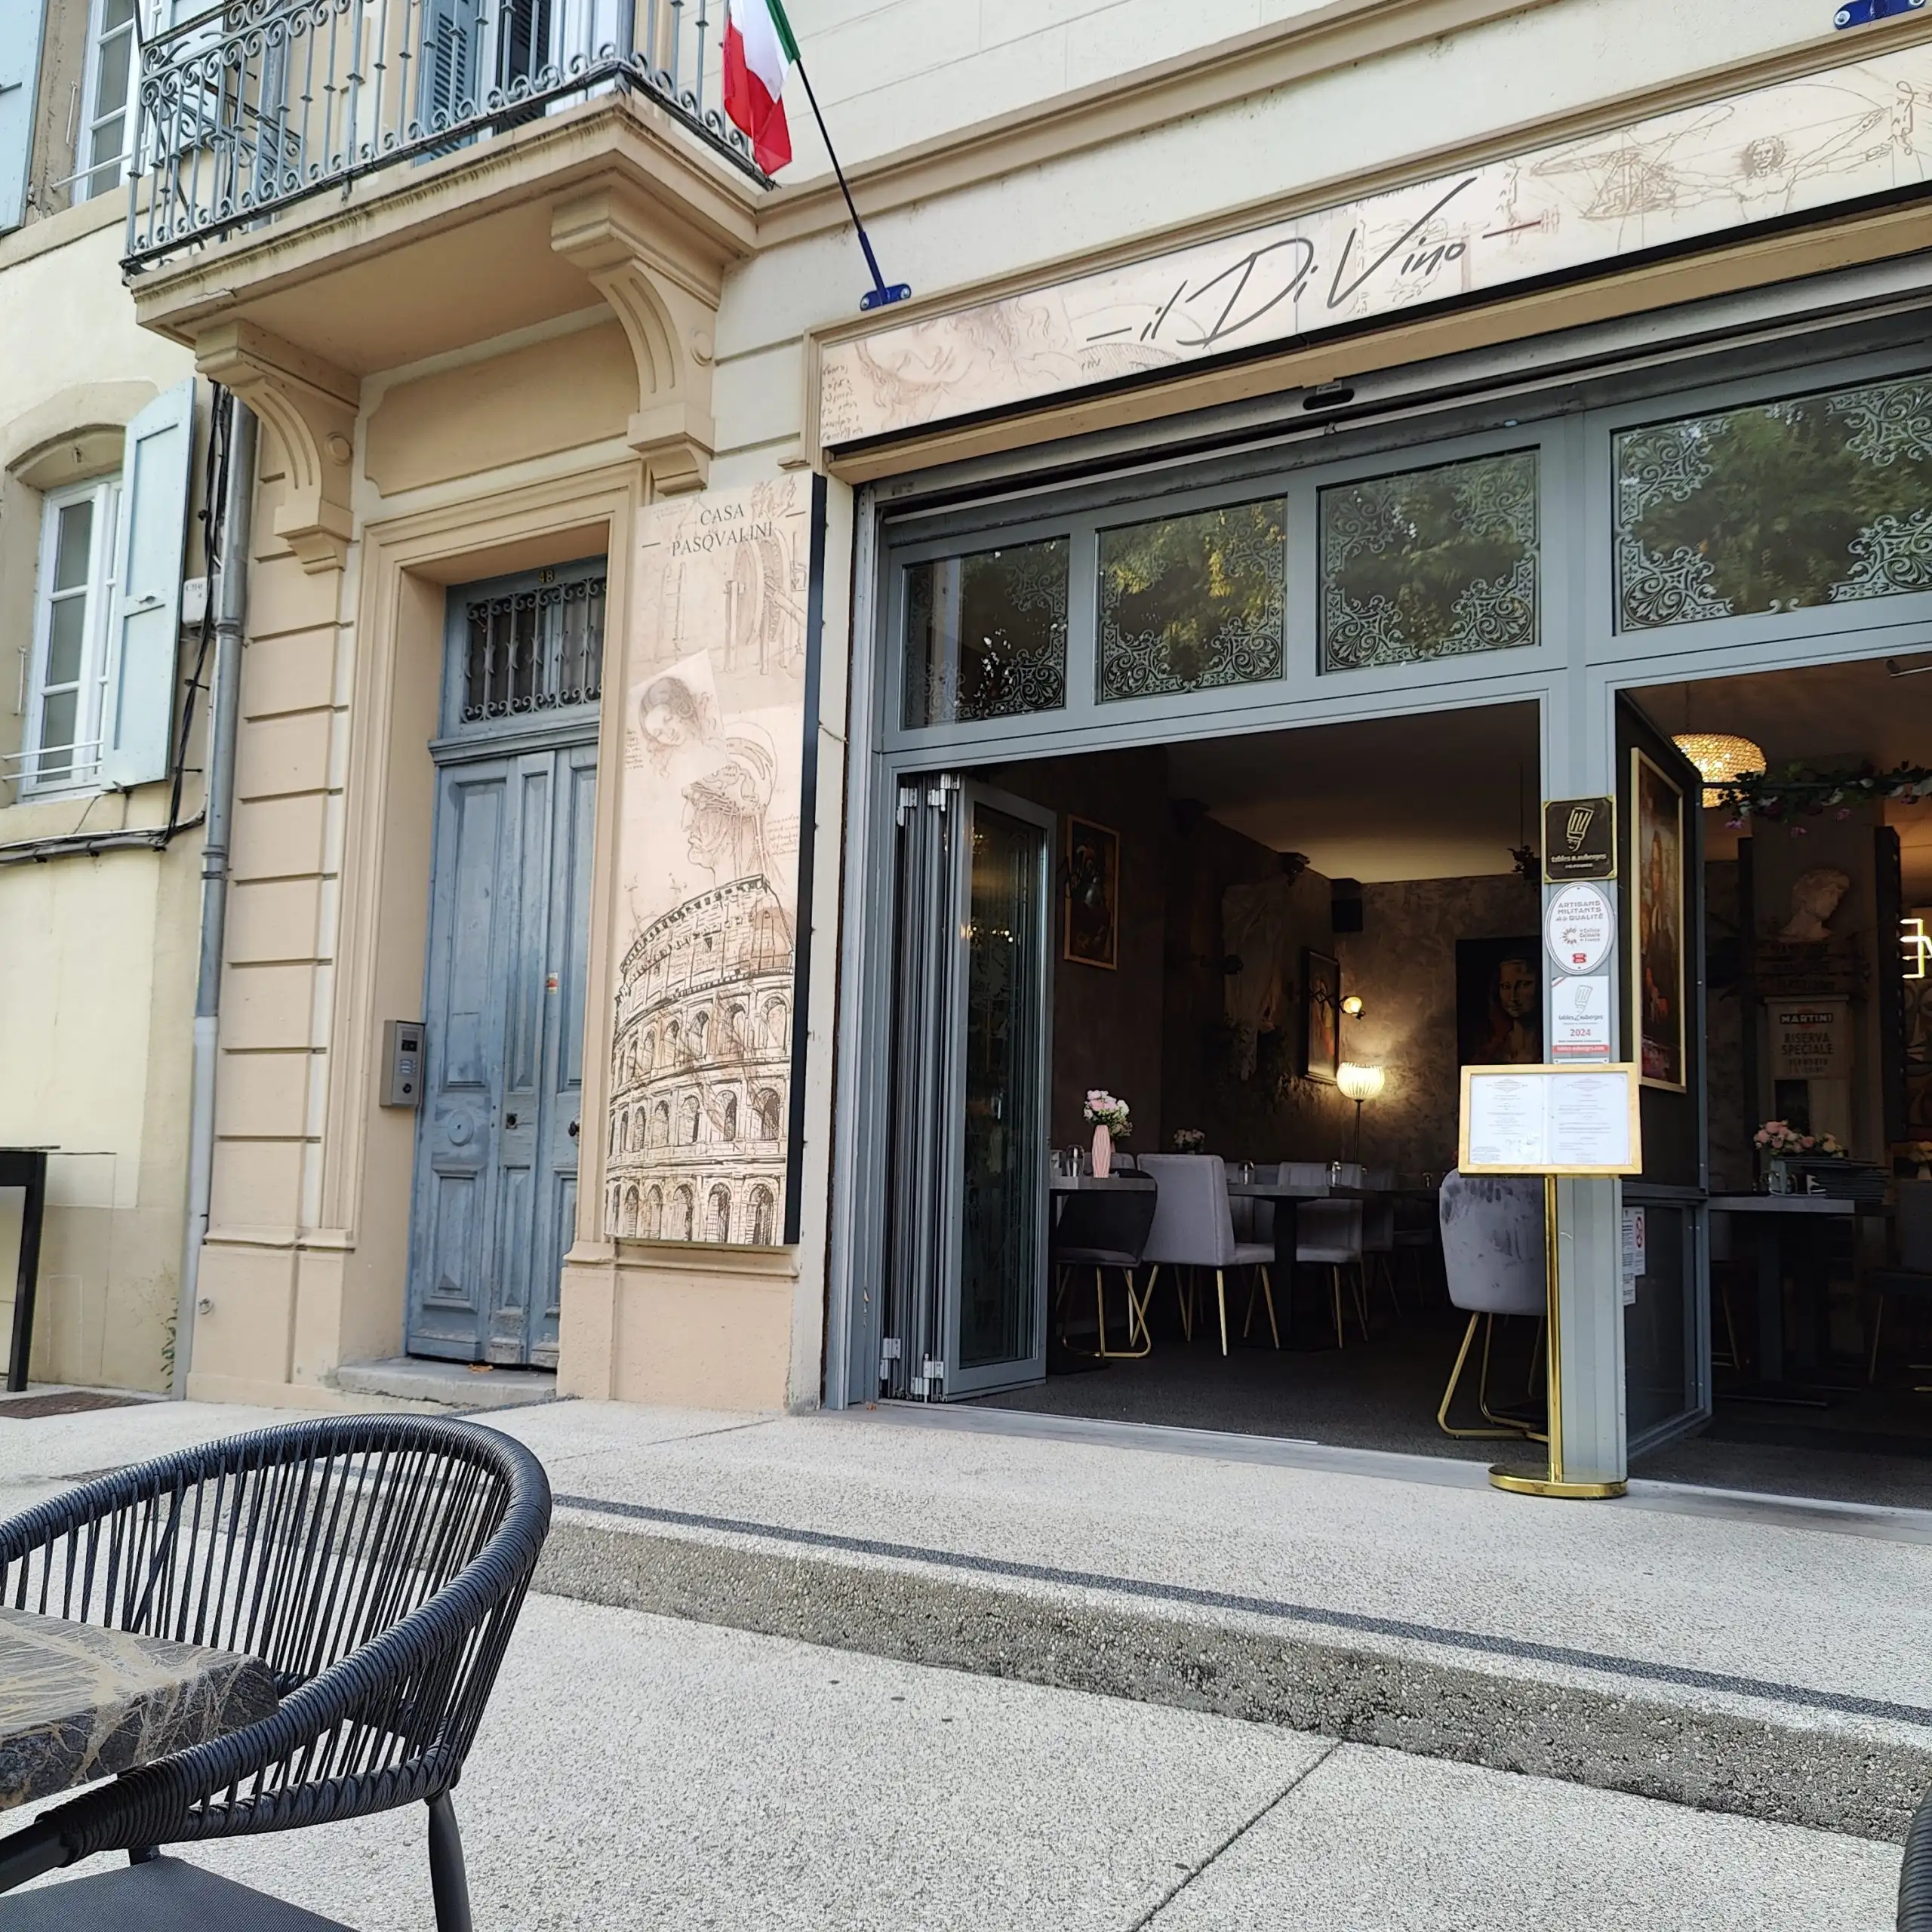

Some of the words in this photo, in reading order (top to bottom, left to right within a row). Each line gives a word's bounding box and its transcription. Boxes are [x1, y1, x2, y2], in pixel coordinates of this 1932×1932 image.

[700, 503, 744, 526] CASA
[672, 521, 773, 557] PASQVALINI
[1558, 900, 1601, 909] ARTISANS
[1558, 907, 1601, 915] MILITANTS
[1781, 1014, 1832, 1023] MARTINI
[1783, 1032, 1830, 1043] RISERVA
[1781, 1044, 1834, 1056] SPECIALE
